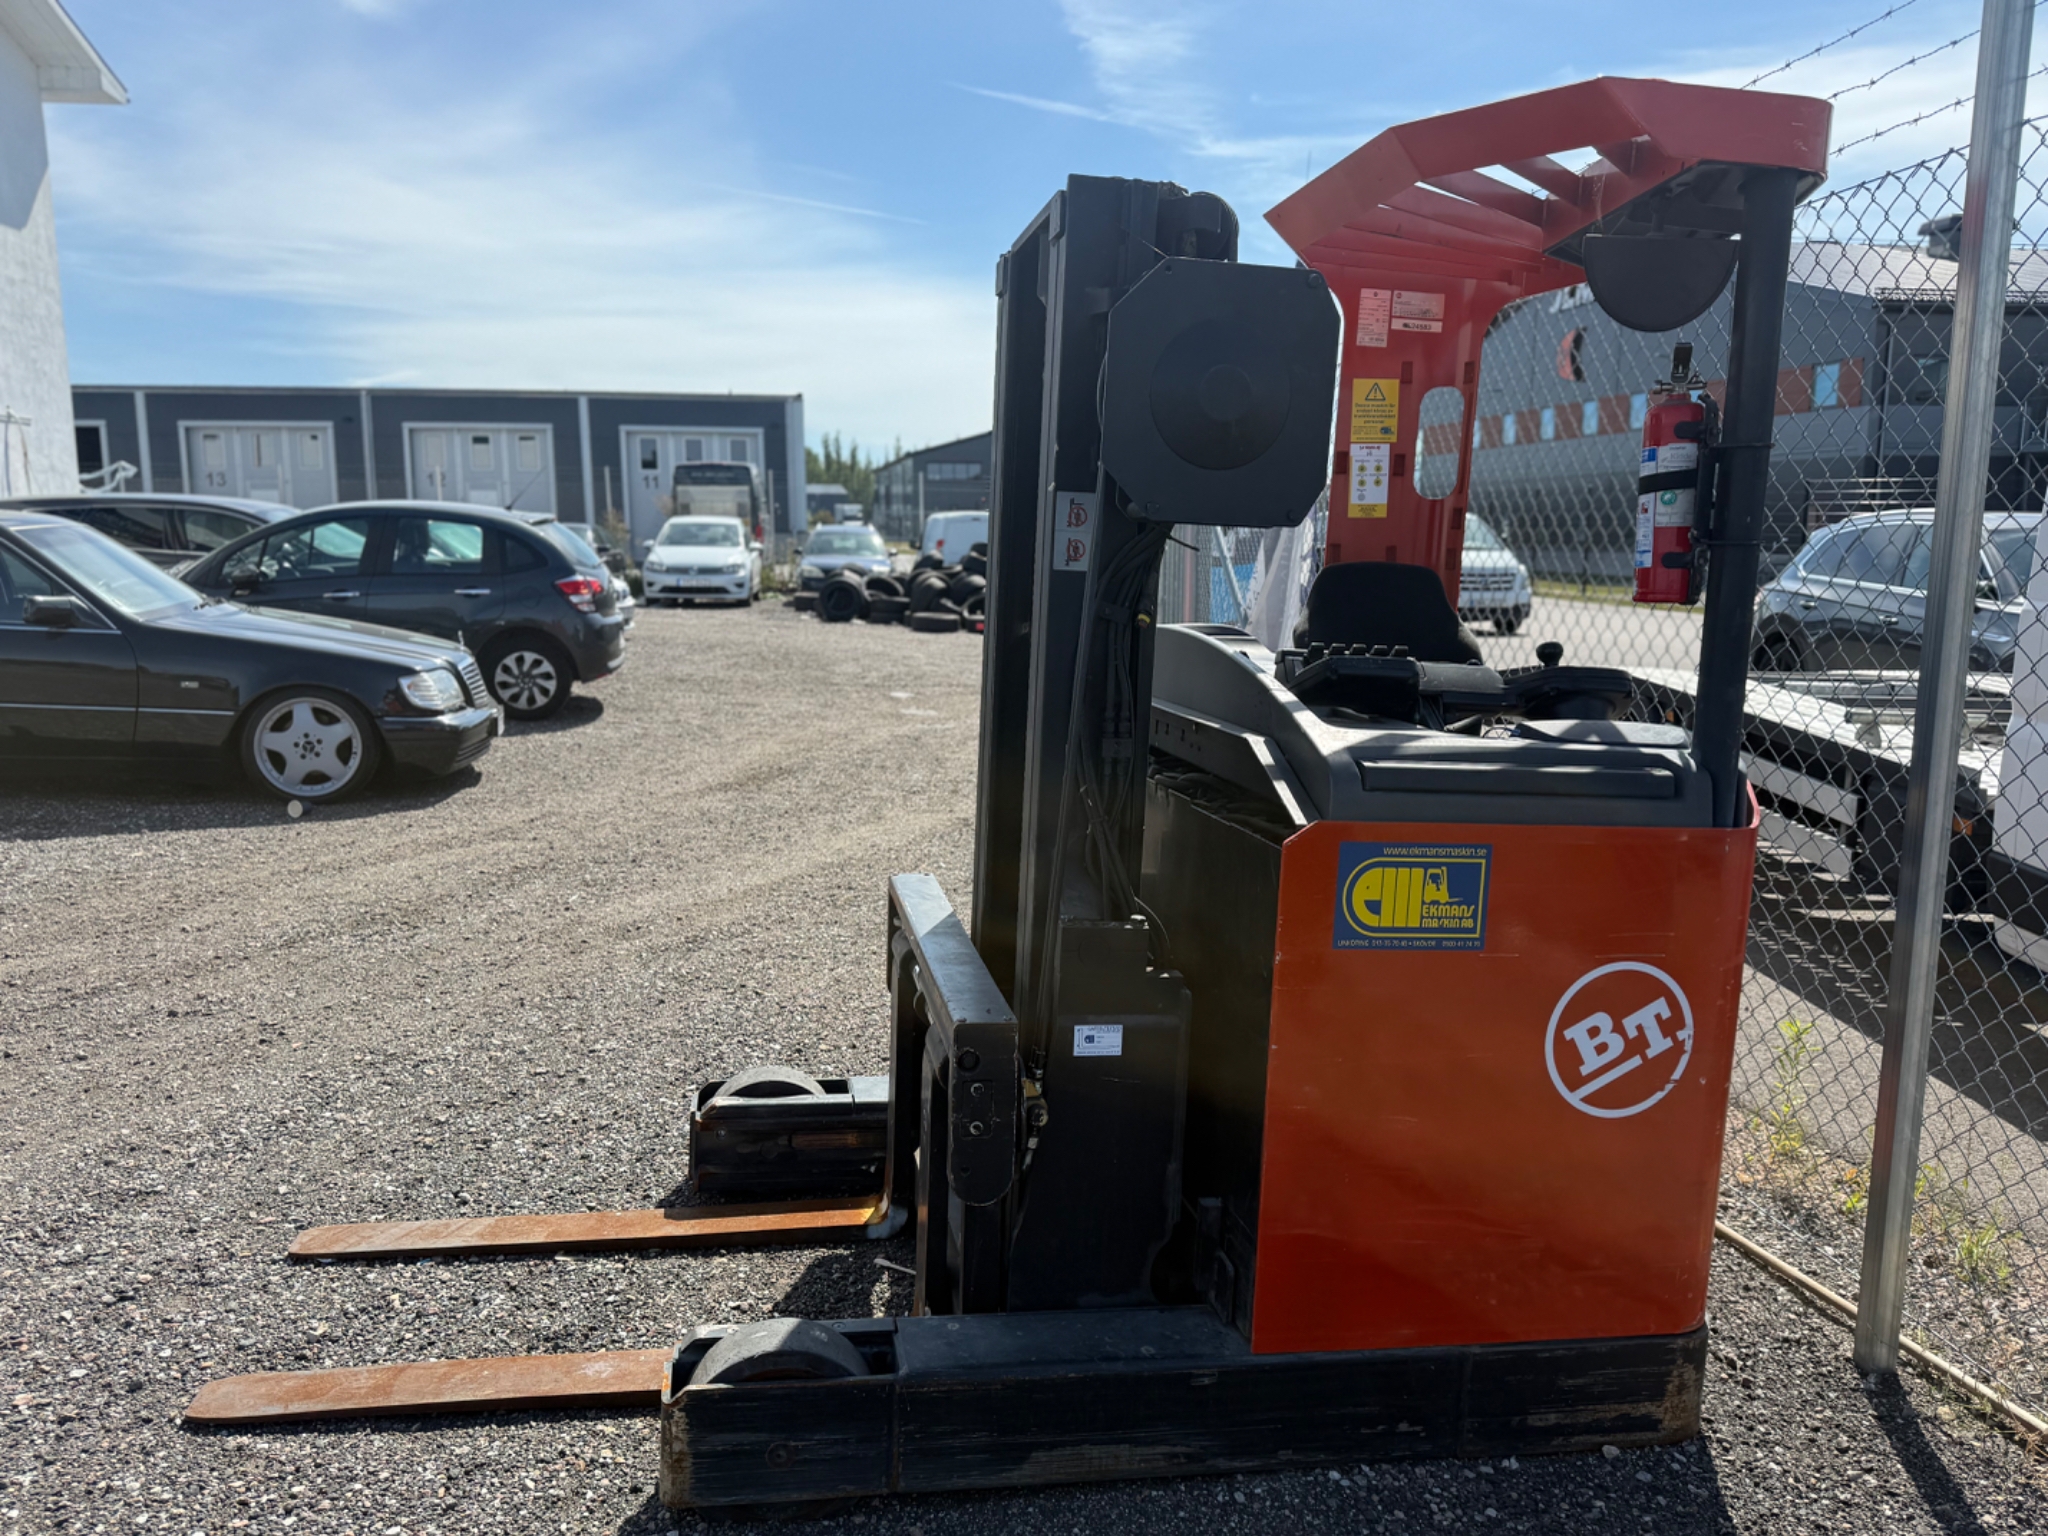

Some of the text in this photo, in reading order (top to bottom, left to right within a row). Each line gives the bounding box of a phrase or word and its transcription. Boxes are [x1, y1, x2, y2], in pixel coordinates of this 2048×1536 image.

[206, 472, 227, 487] 13
[642, 475, 659, 489] 11
[1383, 846, 1488, 857] www.ekmansmaskin.se
[1422, 904, 1475, 917] EKMANS
[1422, 918, 1474, 928] MASKIN AB
